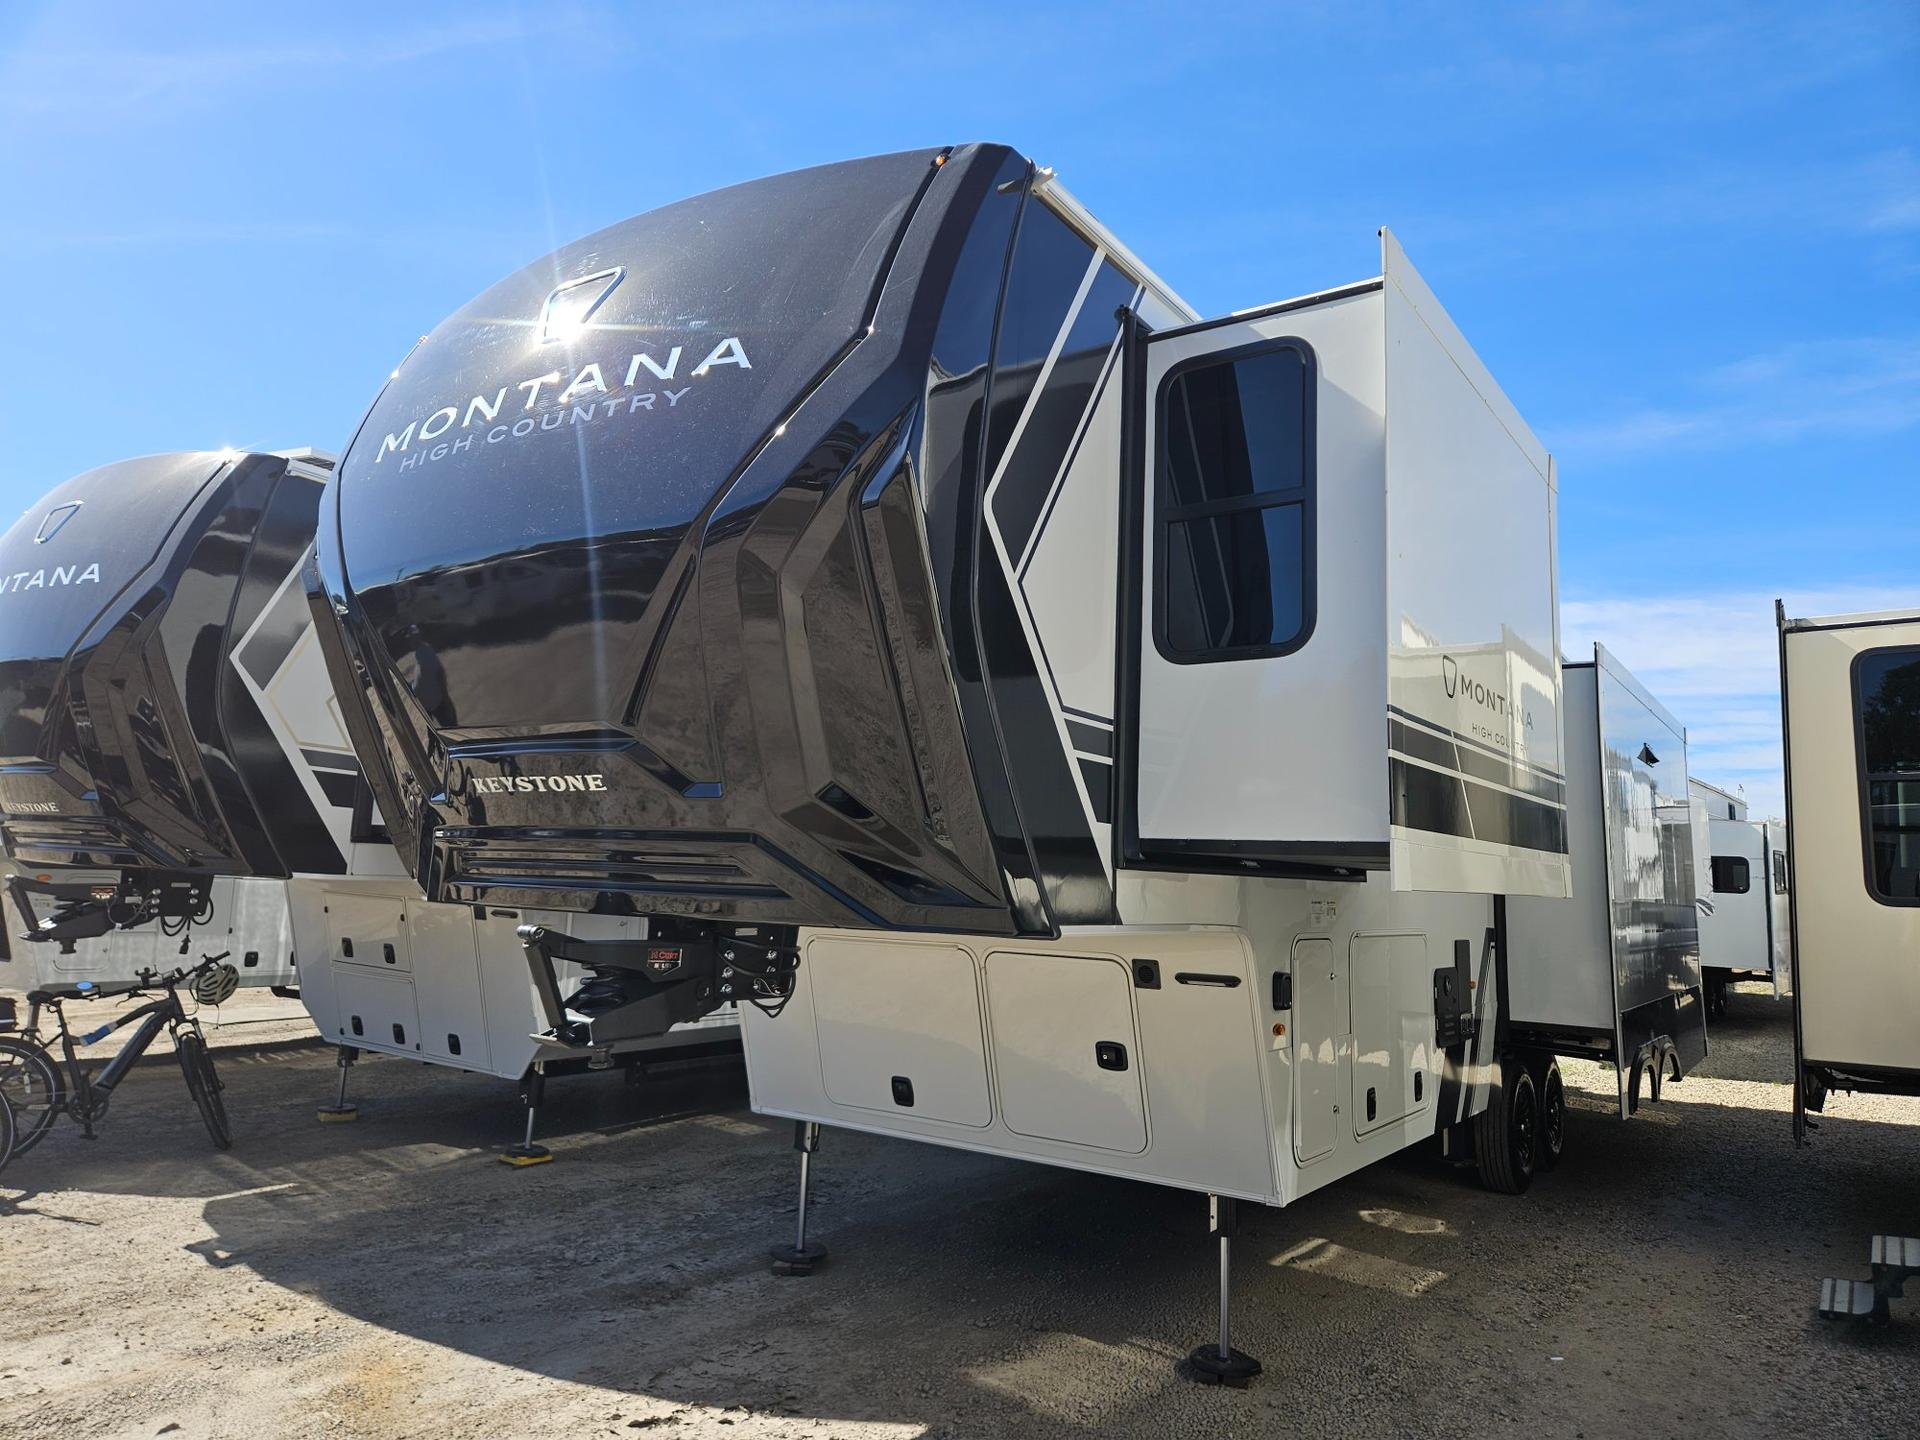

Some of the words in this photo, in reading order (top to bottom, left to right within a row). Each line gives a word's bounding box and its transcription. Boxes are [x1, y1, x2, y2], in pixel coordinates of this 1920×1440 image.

[375, 337, 752, 463] MONTANA
[400, 434, 473, 473] HIGH
[487, 386, 692, 444] COUNTRY
[1461, 674, 1534, 730] MONTANA
[1472, 723, 1492, 741] HIGH
[472, 775, 607, 793] KEYSTONE
